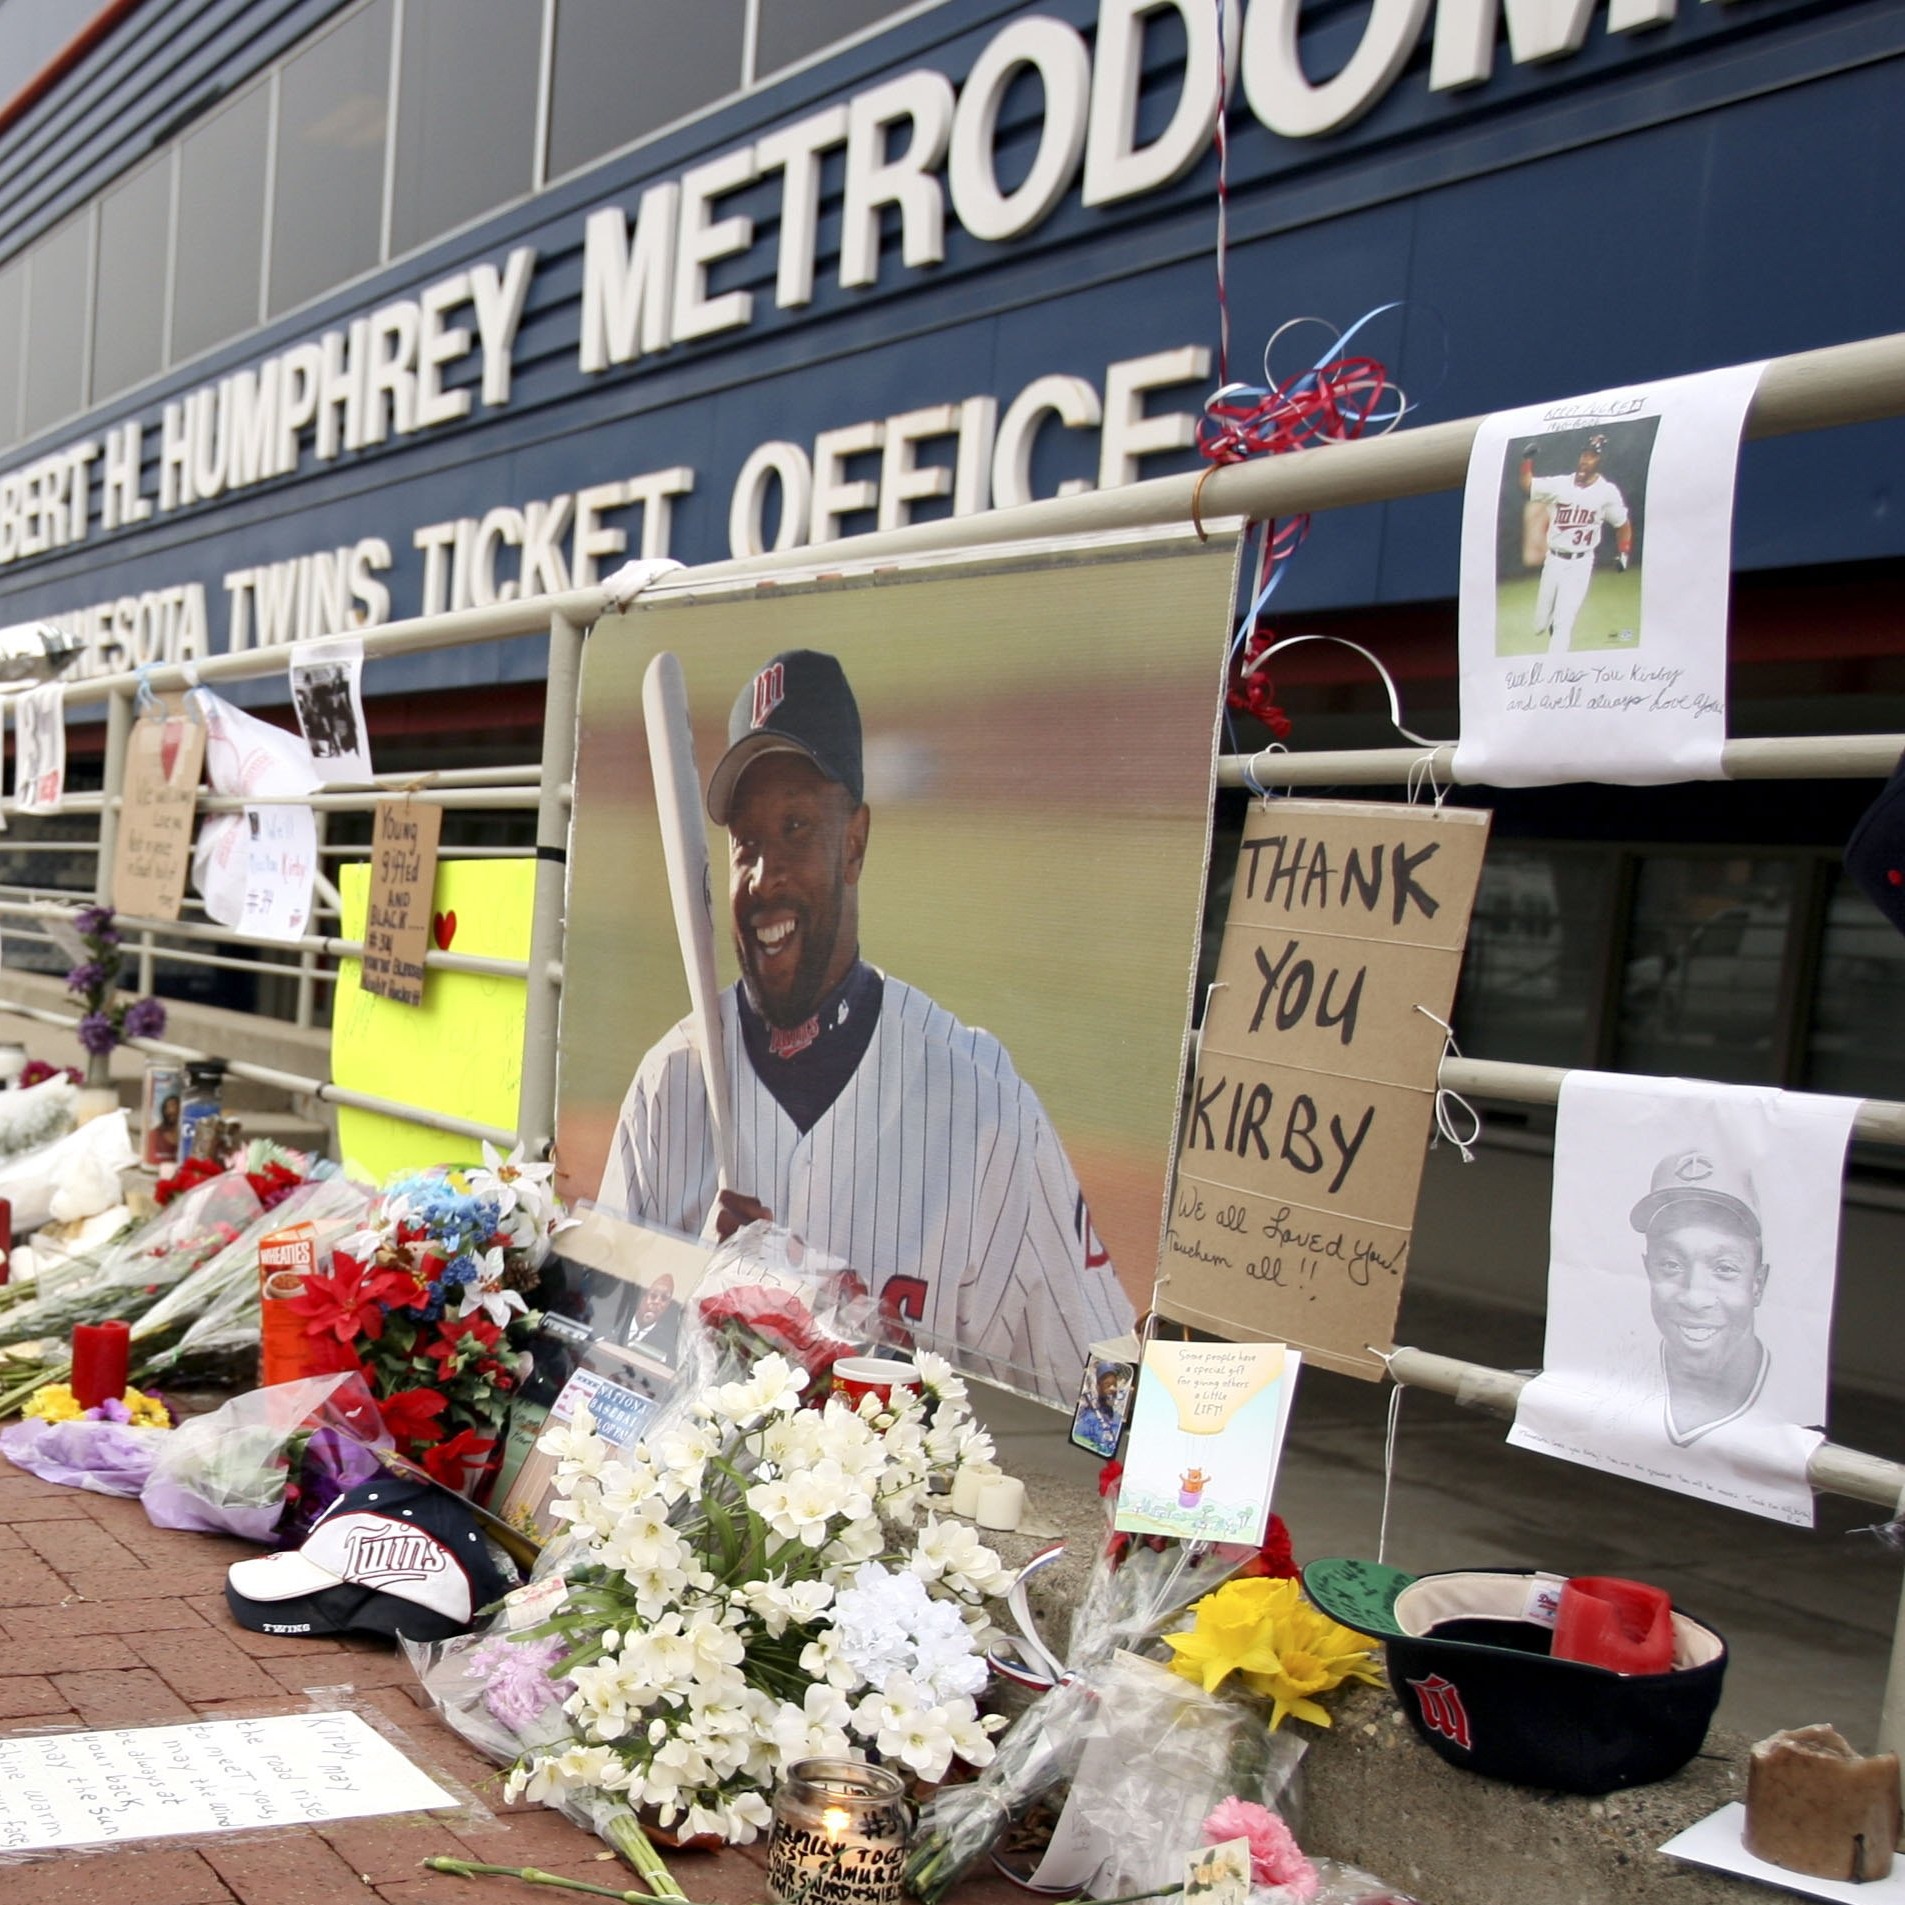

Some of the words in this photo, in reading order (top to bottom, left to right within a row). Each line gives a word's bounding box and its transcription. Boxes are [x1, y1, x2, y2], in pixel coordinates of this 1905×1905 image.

[160, 246, 537, 512] HUMPHREY
[1554, 503, 1597, 525] Twins
[1572, 530, 1594, 546] 34
[223, 538, 391, 652] TWINS
[414, 466, 694, 616] TICKET
[1241, 835, 1441, 926] THANK
[387, 890, 412, 907] AND
[1249, 939, 1368, 1046] YOU
[1187, 1075, 1376, 1194] KIRBY
[1216, 1205, 1248, 1234] all
[261, 1240, 312, 1266] WHEATIES
[1179, 1349, 1203, 1361] Some
[1205, 1352, 1236, 1363] people
[1239, 1351, 1256, 1361] have
[1194, 1366, 1226, 1375] special
[1228, 1365, 1245, 1377] gift
[1194, 1380, 1220, 1390] giving
[1222, 1377, 1250, 1389] others
[1193, 1402, 1223, 1417] LIFT!
[343, 1523, 446, 1583] Twins
[262, 1623, 311, 1634] TWINS
[187, 1725, 214, 1740] to
[72, 1735, 115, 1768] your
[34, 1739, 76, 1769] may
[67, 1777, 97, 1800] the
[115, 1731, 137, 1745] be
[128, 1750, 165, 1787] always
[156, 1791, 187, 1805] at
[162, 1740, 197, 1771] may
[190, 1778, 217, 1797] the
[236, 1721, 265, 1744] the
[260, 1755, 308, 1780] road
[291, 1790, 329, 1818] rise
[318, 1765, 360, 1791] may
[23, 1790, 62, 1837] warm
